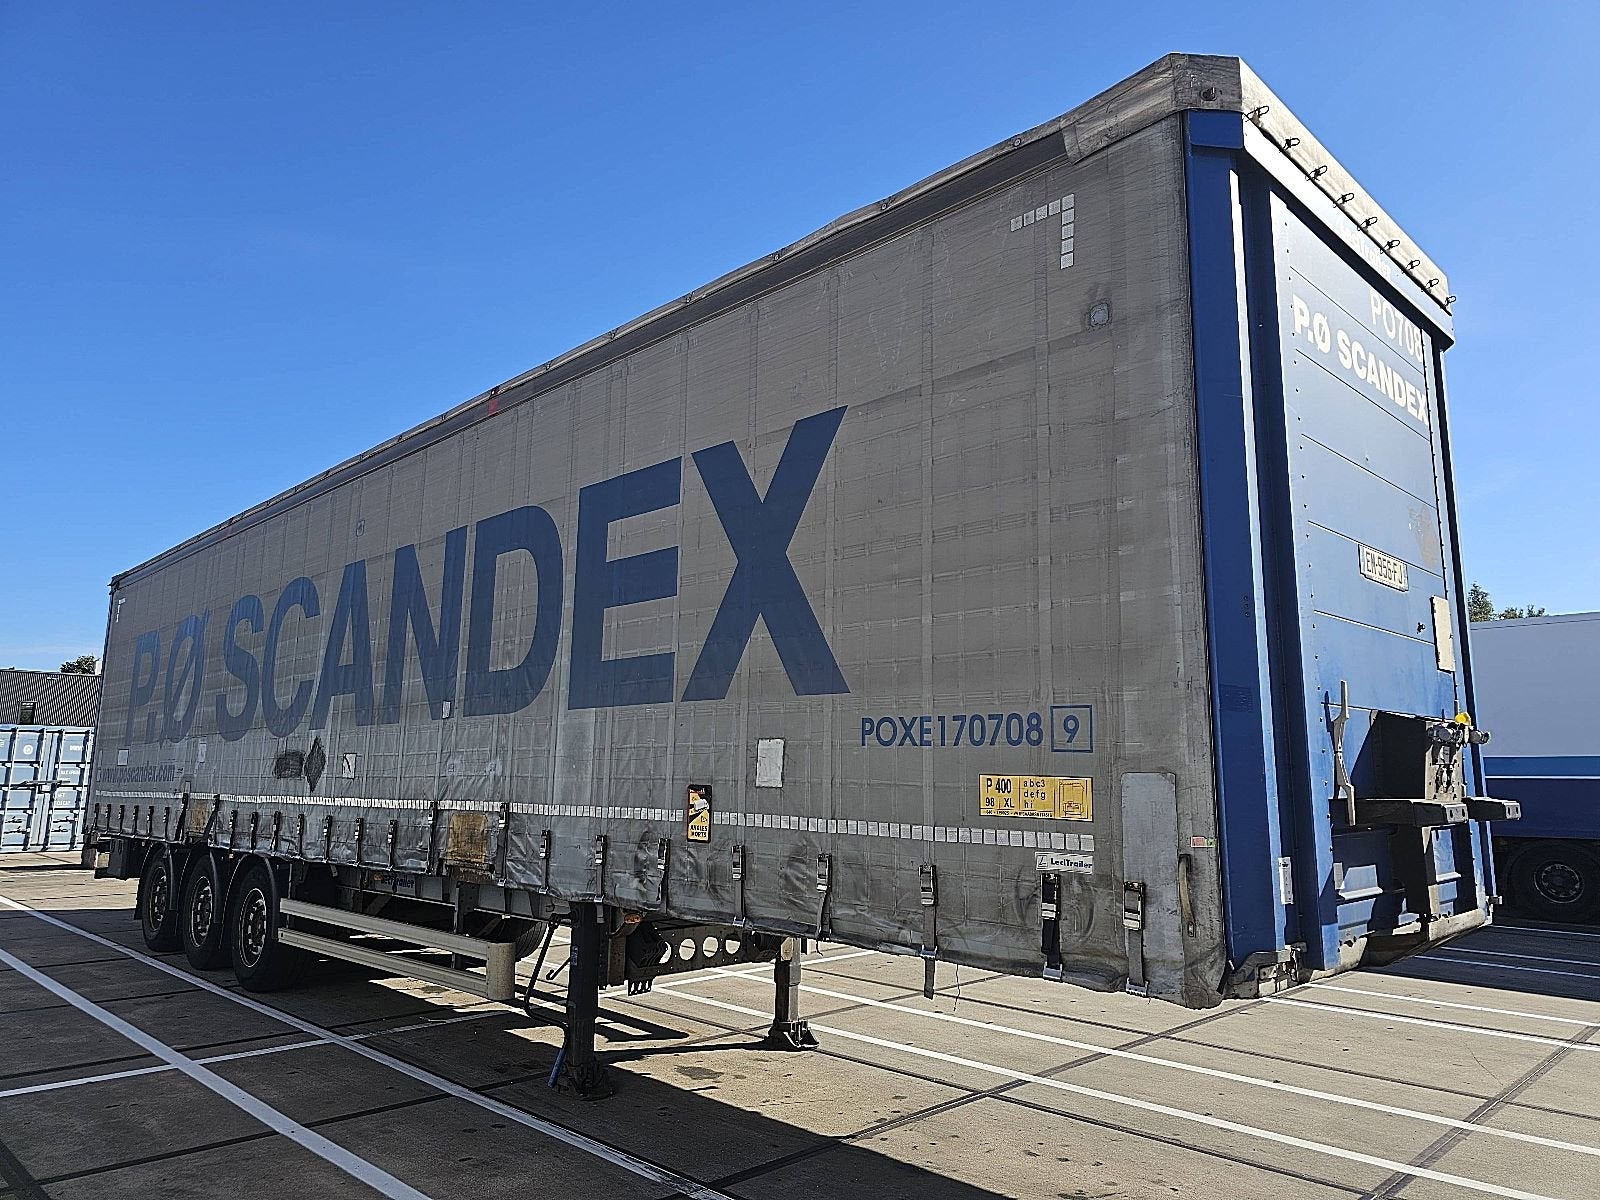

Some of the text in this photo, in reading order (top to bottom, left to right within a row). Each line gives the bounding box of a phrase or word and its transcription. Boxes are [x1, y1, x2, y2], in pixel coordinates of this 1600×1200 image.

[1370, 287, 1423, 363] PO708
[1337, 329, 1429, 427] SCANDEX
[215, 404, 851, 742] SCANDEX
[860, 711, 1080, 747] POXE170708 9
[985, 796, 1015, 808] 98 XL
[986, 777, 1012, 794] P 400
[1050, 857, 1093, 869] LeciTrailer
